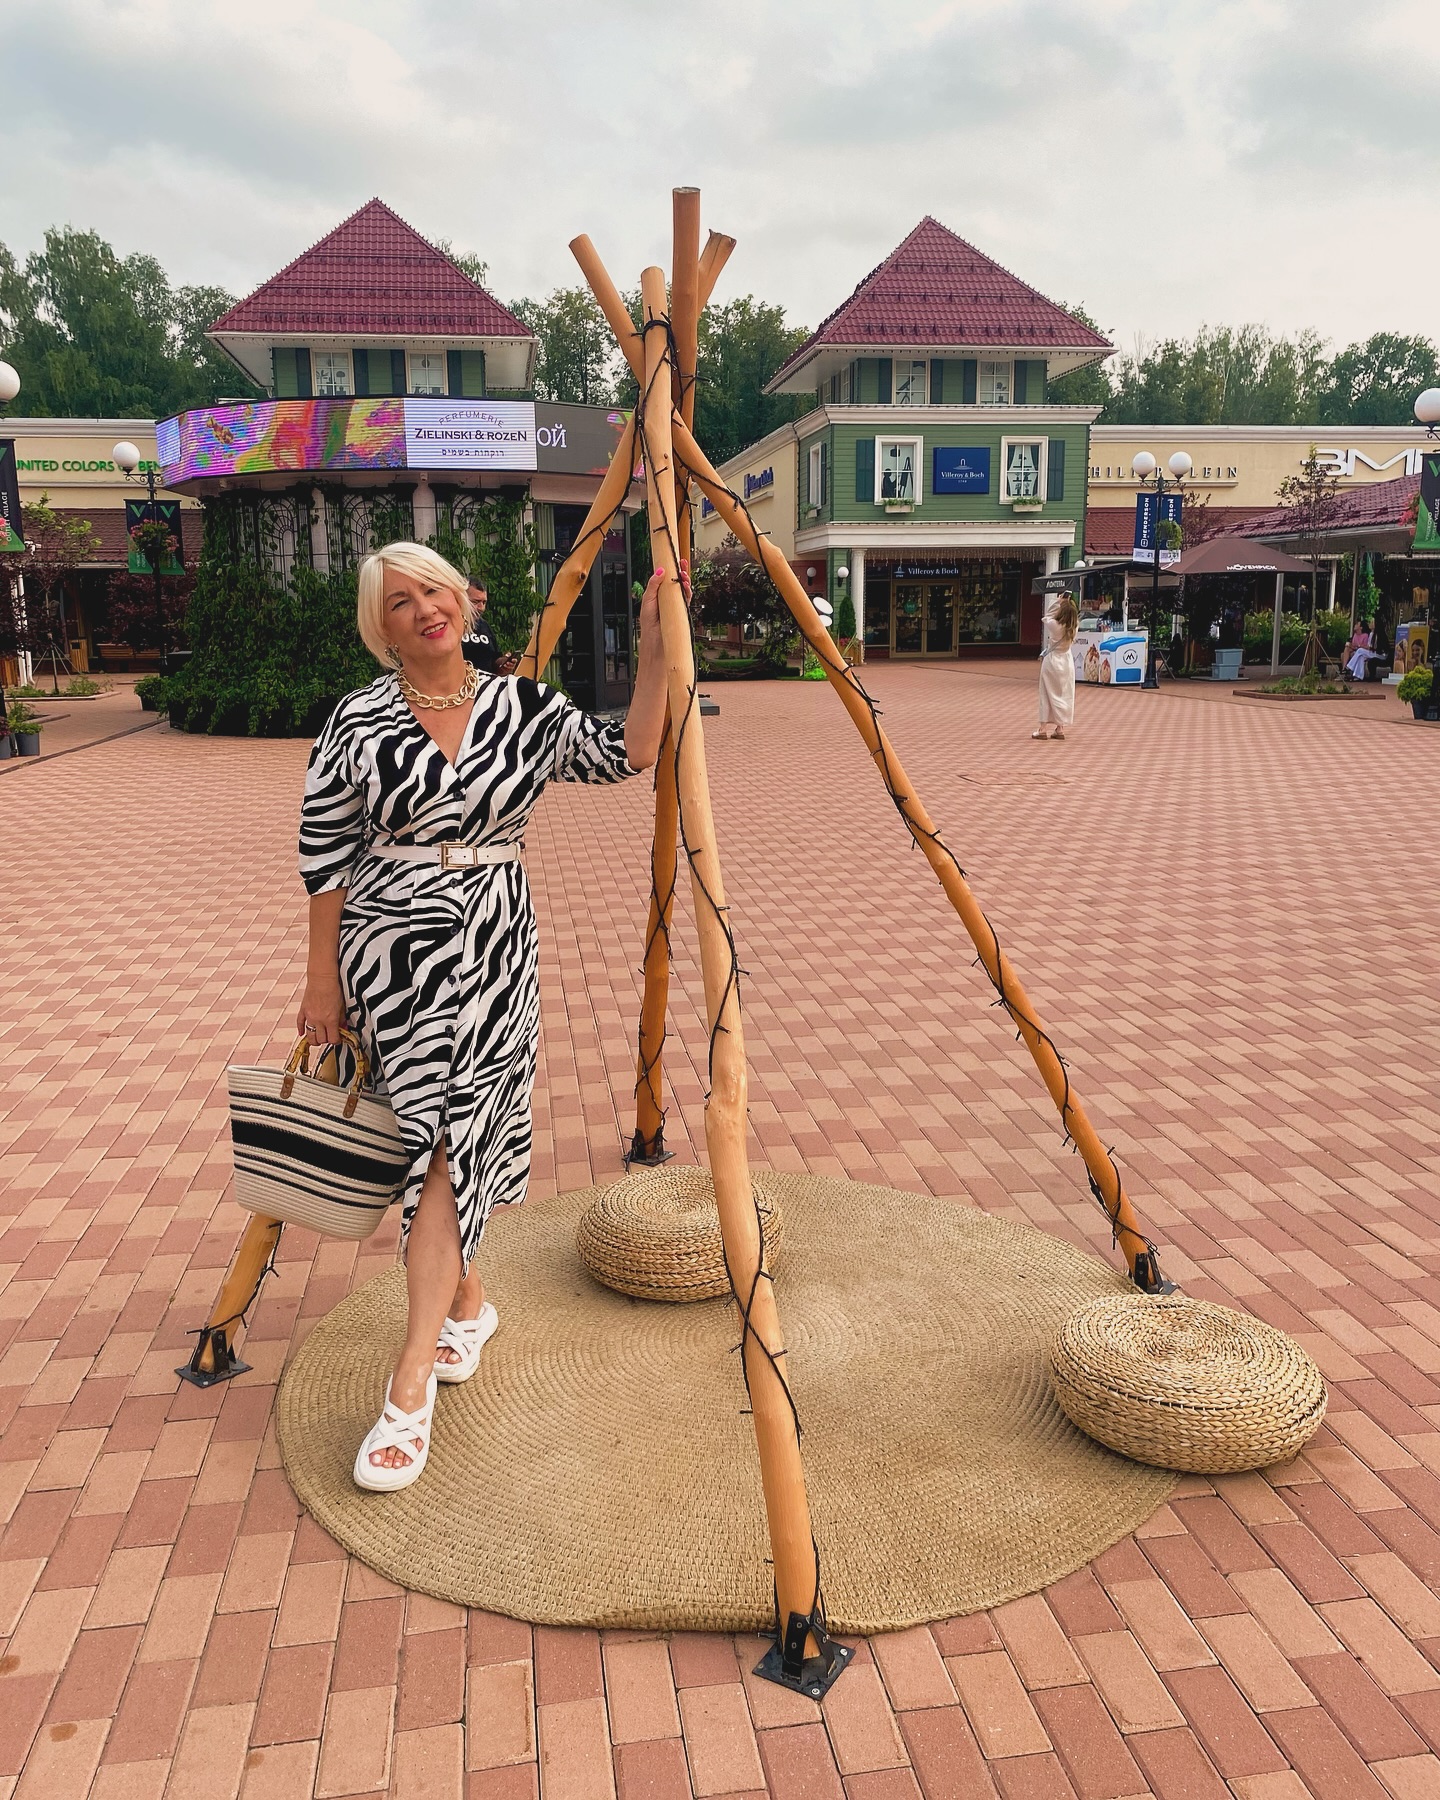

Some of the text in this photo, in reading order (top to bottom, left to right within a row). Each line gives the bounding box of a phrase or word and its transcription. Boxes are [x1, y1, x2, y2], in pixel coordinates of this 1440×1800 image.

[439, 410, 504, 428] PERFUMERIE
[414, 428, 527, 441] ZIELINSKI & ROZEN
[62, 460, 115, 472] COLORS
[1189, 466, 1238, 478] LEIN
[1, 491, 9, 518] VILLAGE
[1142, 497, 1150, 538] HENDERSON
[907, 567, 935, 575] Villeroy
[941, 567, 959, 575] Boch
[462, 633, 489, 645] UGO
